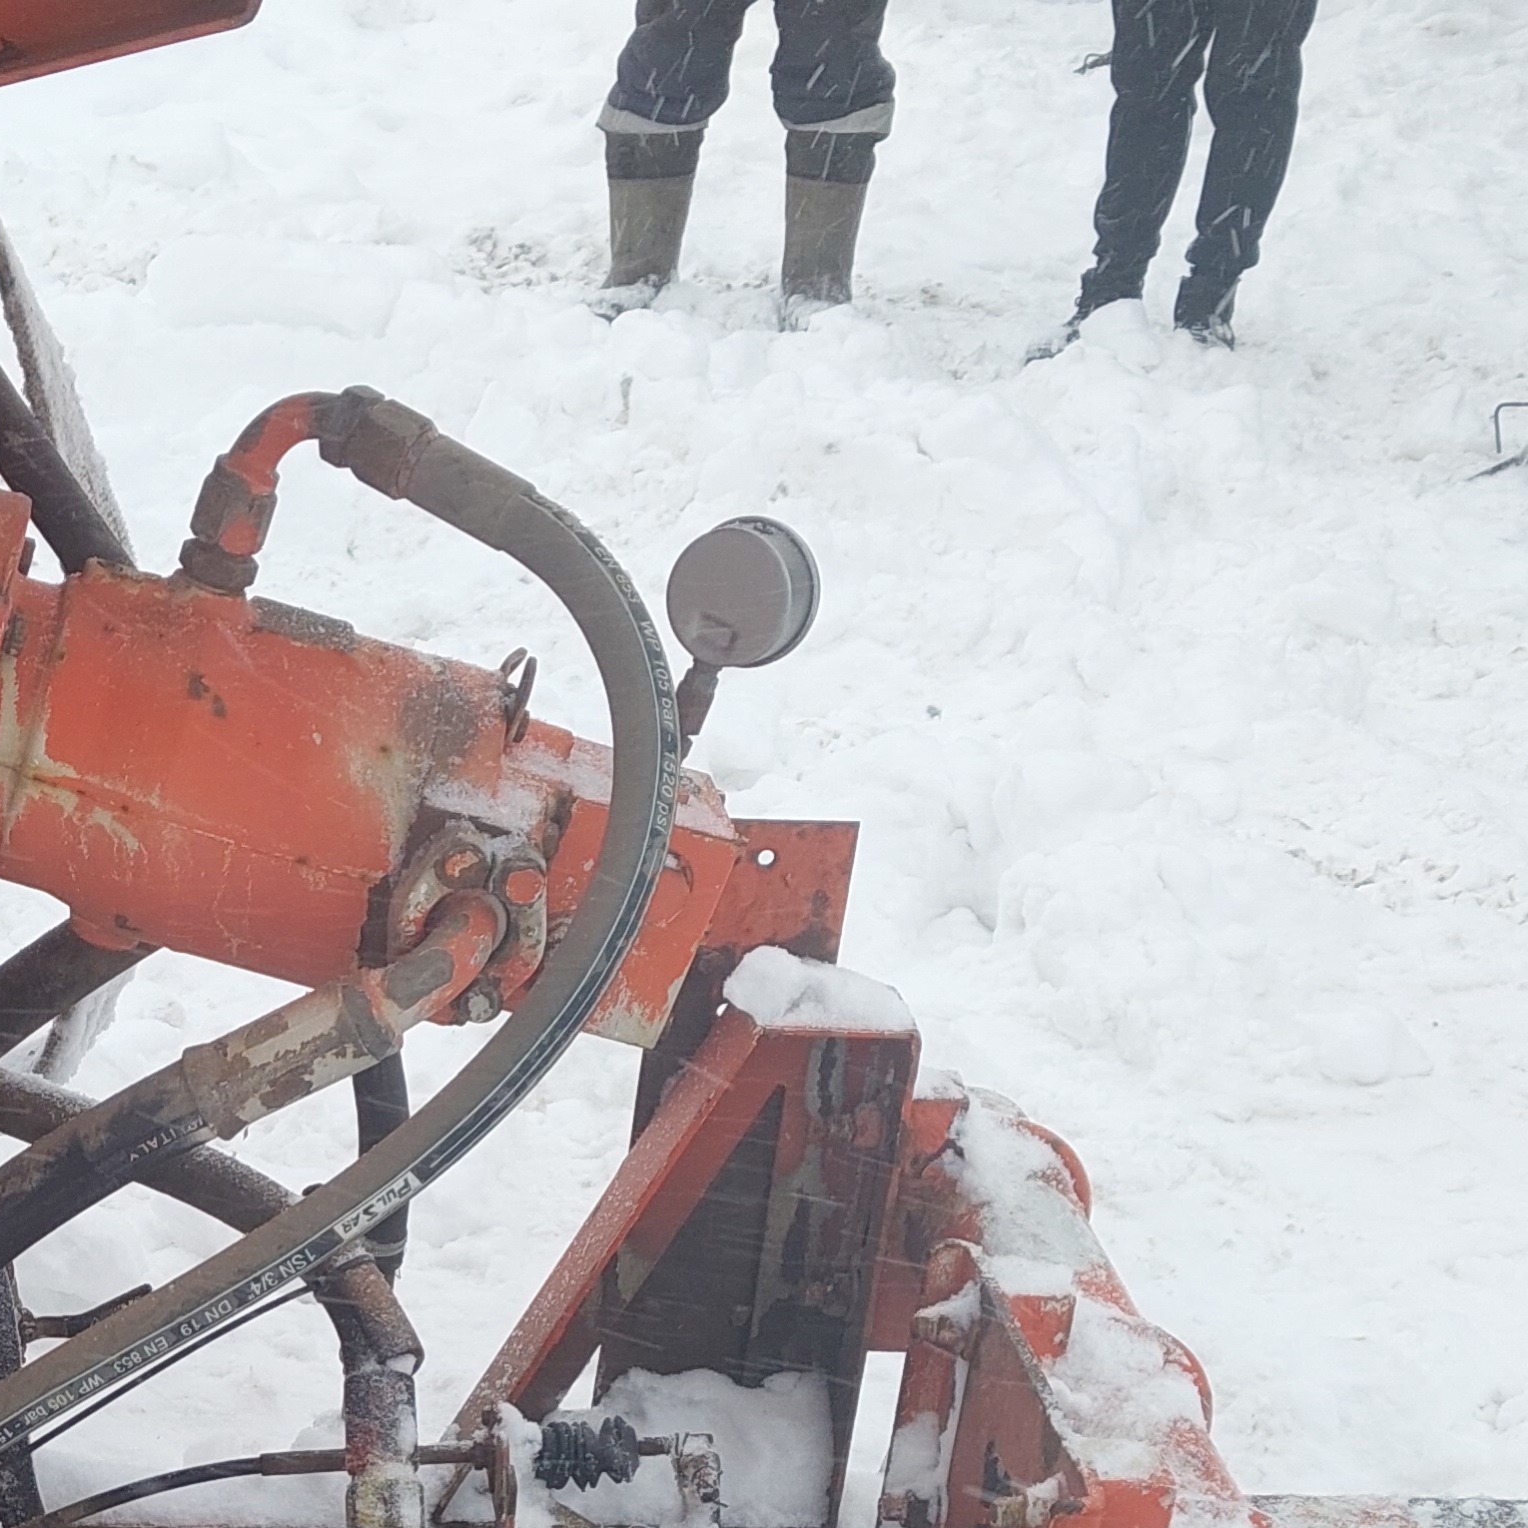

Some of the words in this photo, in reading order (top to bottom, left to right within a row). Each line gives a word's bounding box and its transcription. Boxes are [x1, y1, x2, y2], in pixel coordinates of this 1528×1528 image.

[640, 620, 661, 652] WP
[654, 660, 669, 691] 105
[660, 697, 673, 730] bar
[662, 751, 676, 798] 1520
[655, 800, 674, 836] psi
[278, 1248, 316, 1279] 1SN
[247, 1271, 279, 1300] 3/4"
[204, 1299, 233, 1324] DN
[180, 1317, 202, 1337] 19
[143, 1335, 169, 1358] EN
[113, 1352, 143, 1374] 853
[78, 1373, 105, 1395] WP
[47, 1388, 75, 1412] 105
[23, 1406, 48, 1427] bar
